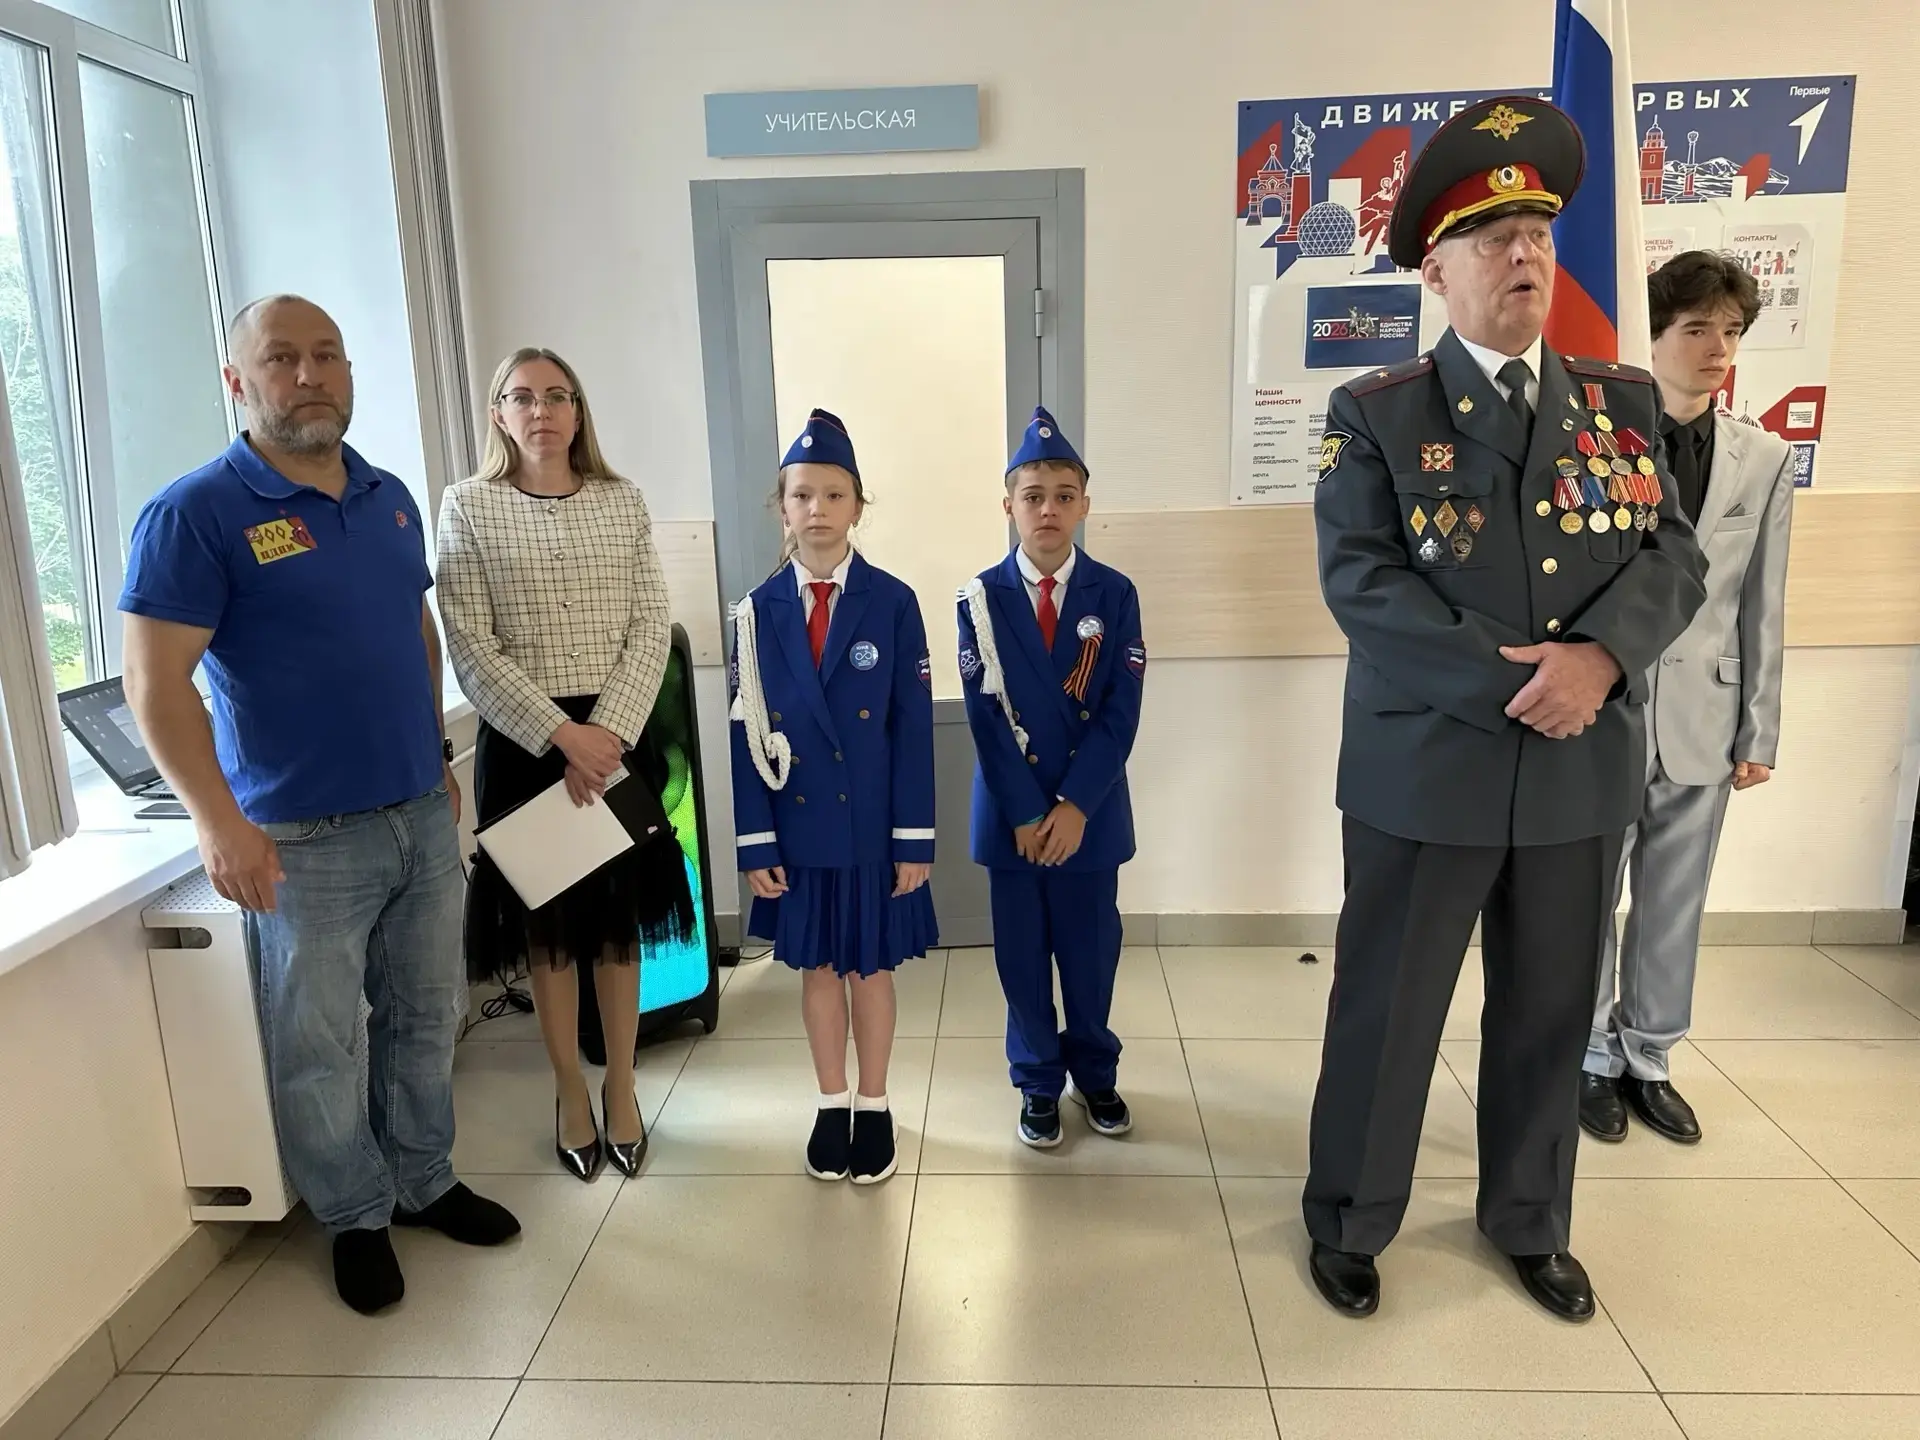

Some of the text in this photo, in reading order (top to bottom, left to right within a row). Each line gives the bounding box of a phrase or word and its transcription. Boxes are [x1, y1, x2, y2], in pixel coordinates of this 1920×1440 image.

[1789, 85, 1831, 97] Первые
[1636, 88, 1751, 112] РВЫХ
[765, 109, 916, 133] УЧИТЕЛЬСКАЯ
[1733, 234, 1777, 242] КОНТАКТЫ
[1312, 322, 1348, 337] 2026
[1255, 388, 1283, 396] Наши
[1255, 398, 1302, 407] ценности
